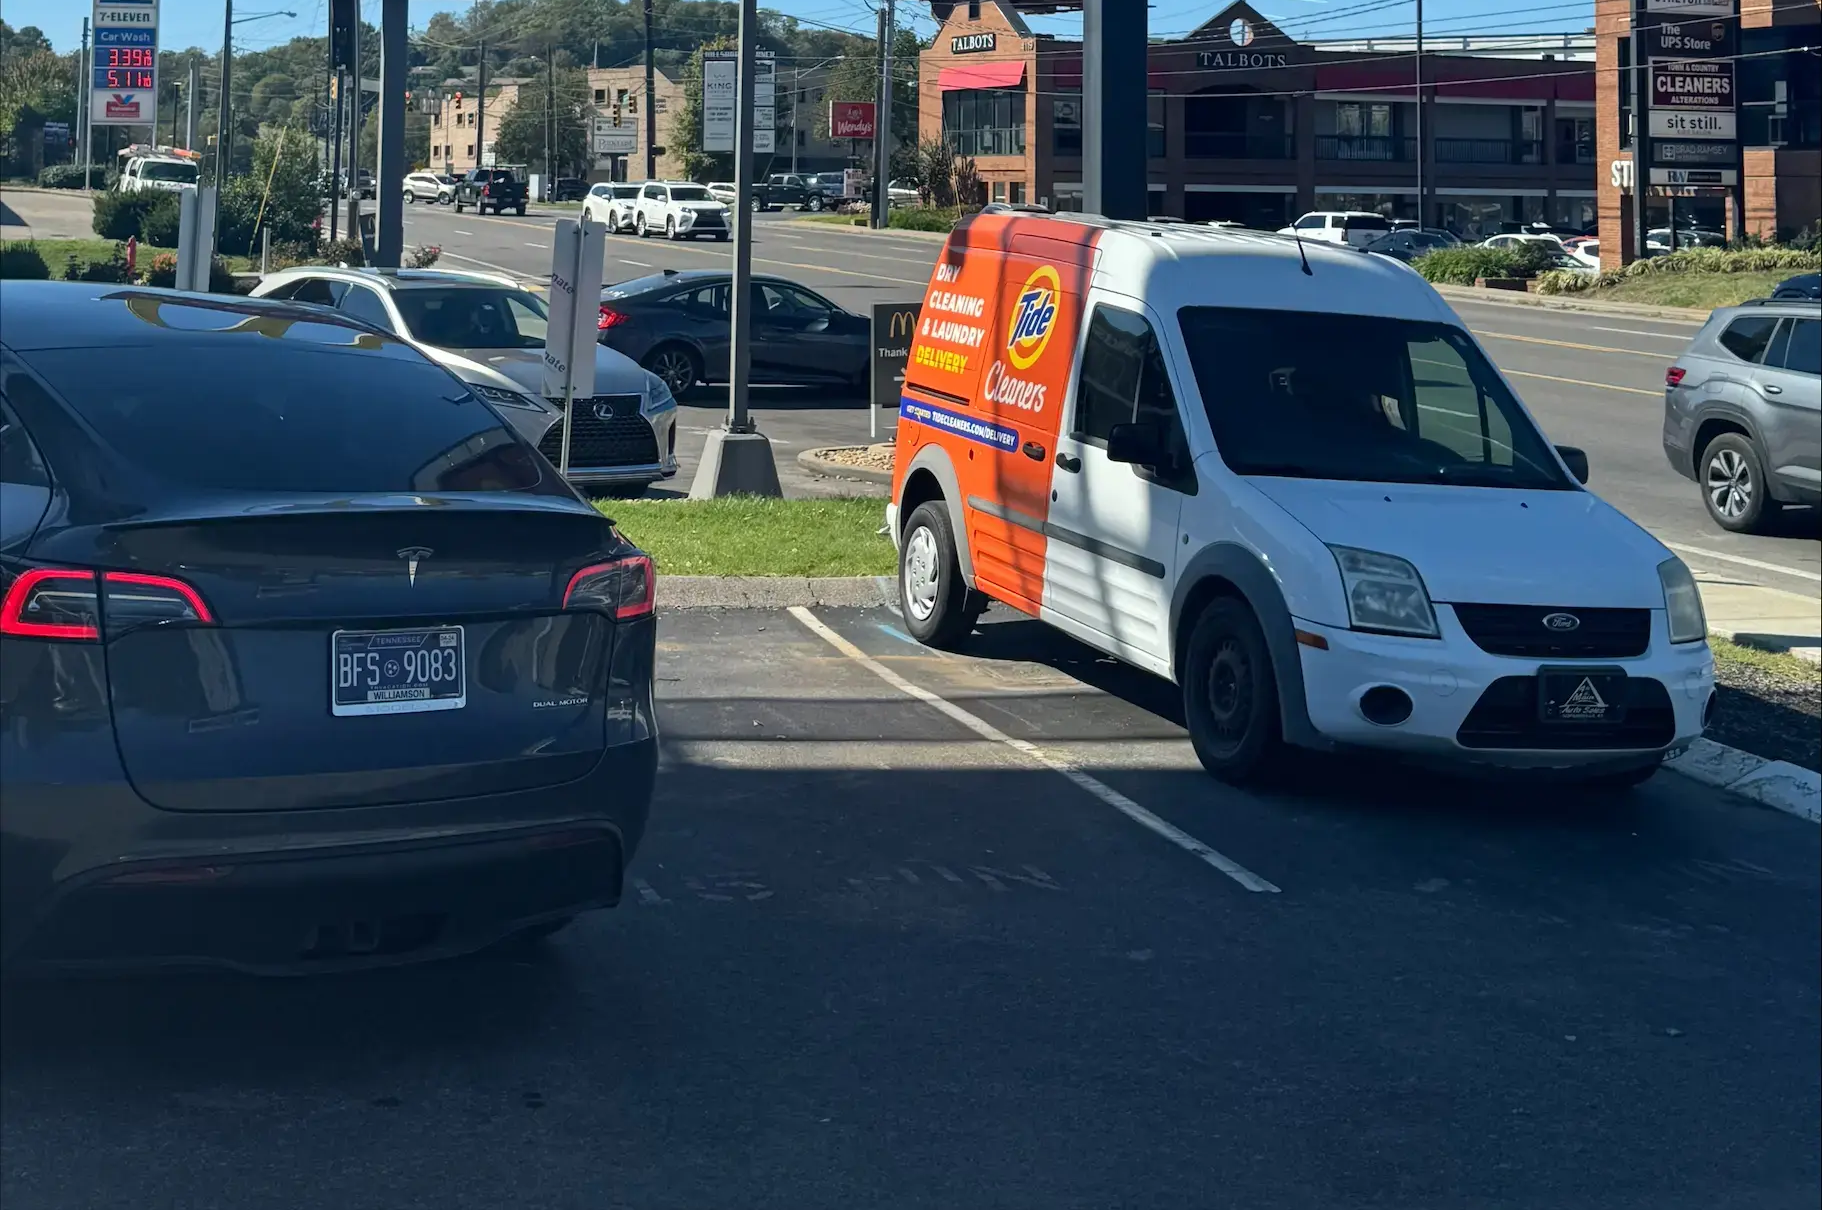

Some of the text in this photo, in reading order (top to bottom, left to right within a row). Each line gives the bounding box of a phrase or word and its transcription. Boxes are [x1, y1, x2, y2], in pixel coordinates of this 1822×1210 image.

[101, 32, 150, 42] Car Wash
[1661, 23, 1680, 35] The
[952, 33, 994, 51] TALBOTS
[1661, 36, 1711, 50] UPS Store
[1200, 52, 1286, 68] TALBOTS
[708, 82, 732, 90] KING
[1657, 76, 1730, 94] CLEANERS
[1671, 96, 1719, 105] ALTERATIONS
[838, 119, 872, 135] Wendy's
[1667, 115, 1722, 130] sit still.
[936, 263, 961, 283] DRY
[929, 290, 985, 317] CLEANING
[1007, 288, 1057, 350] Tide
[922, 317, 985, 348] & LAUNDRY
[878, 347, 908, 357] Thank
[915, 344, 968, 374] DELIVERY
[984, 360, 1047, 413] Cleaners
[932, 410, 1016, 446] TIDECLEANERS.COM/DELIVERY
[376, 635, 421, 645] TENNESSEE
[339, 649, 456, 688] BFS 9083
[373, 690, 425, 700] WILLIAMSON
[559, 698, 588, 706] MOTOR
